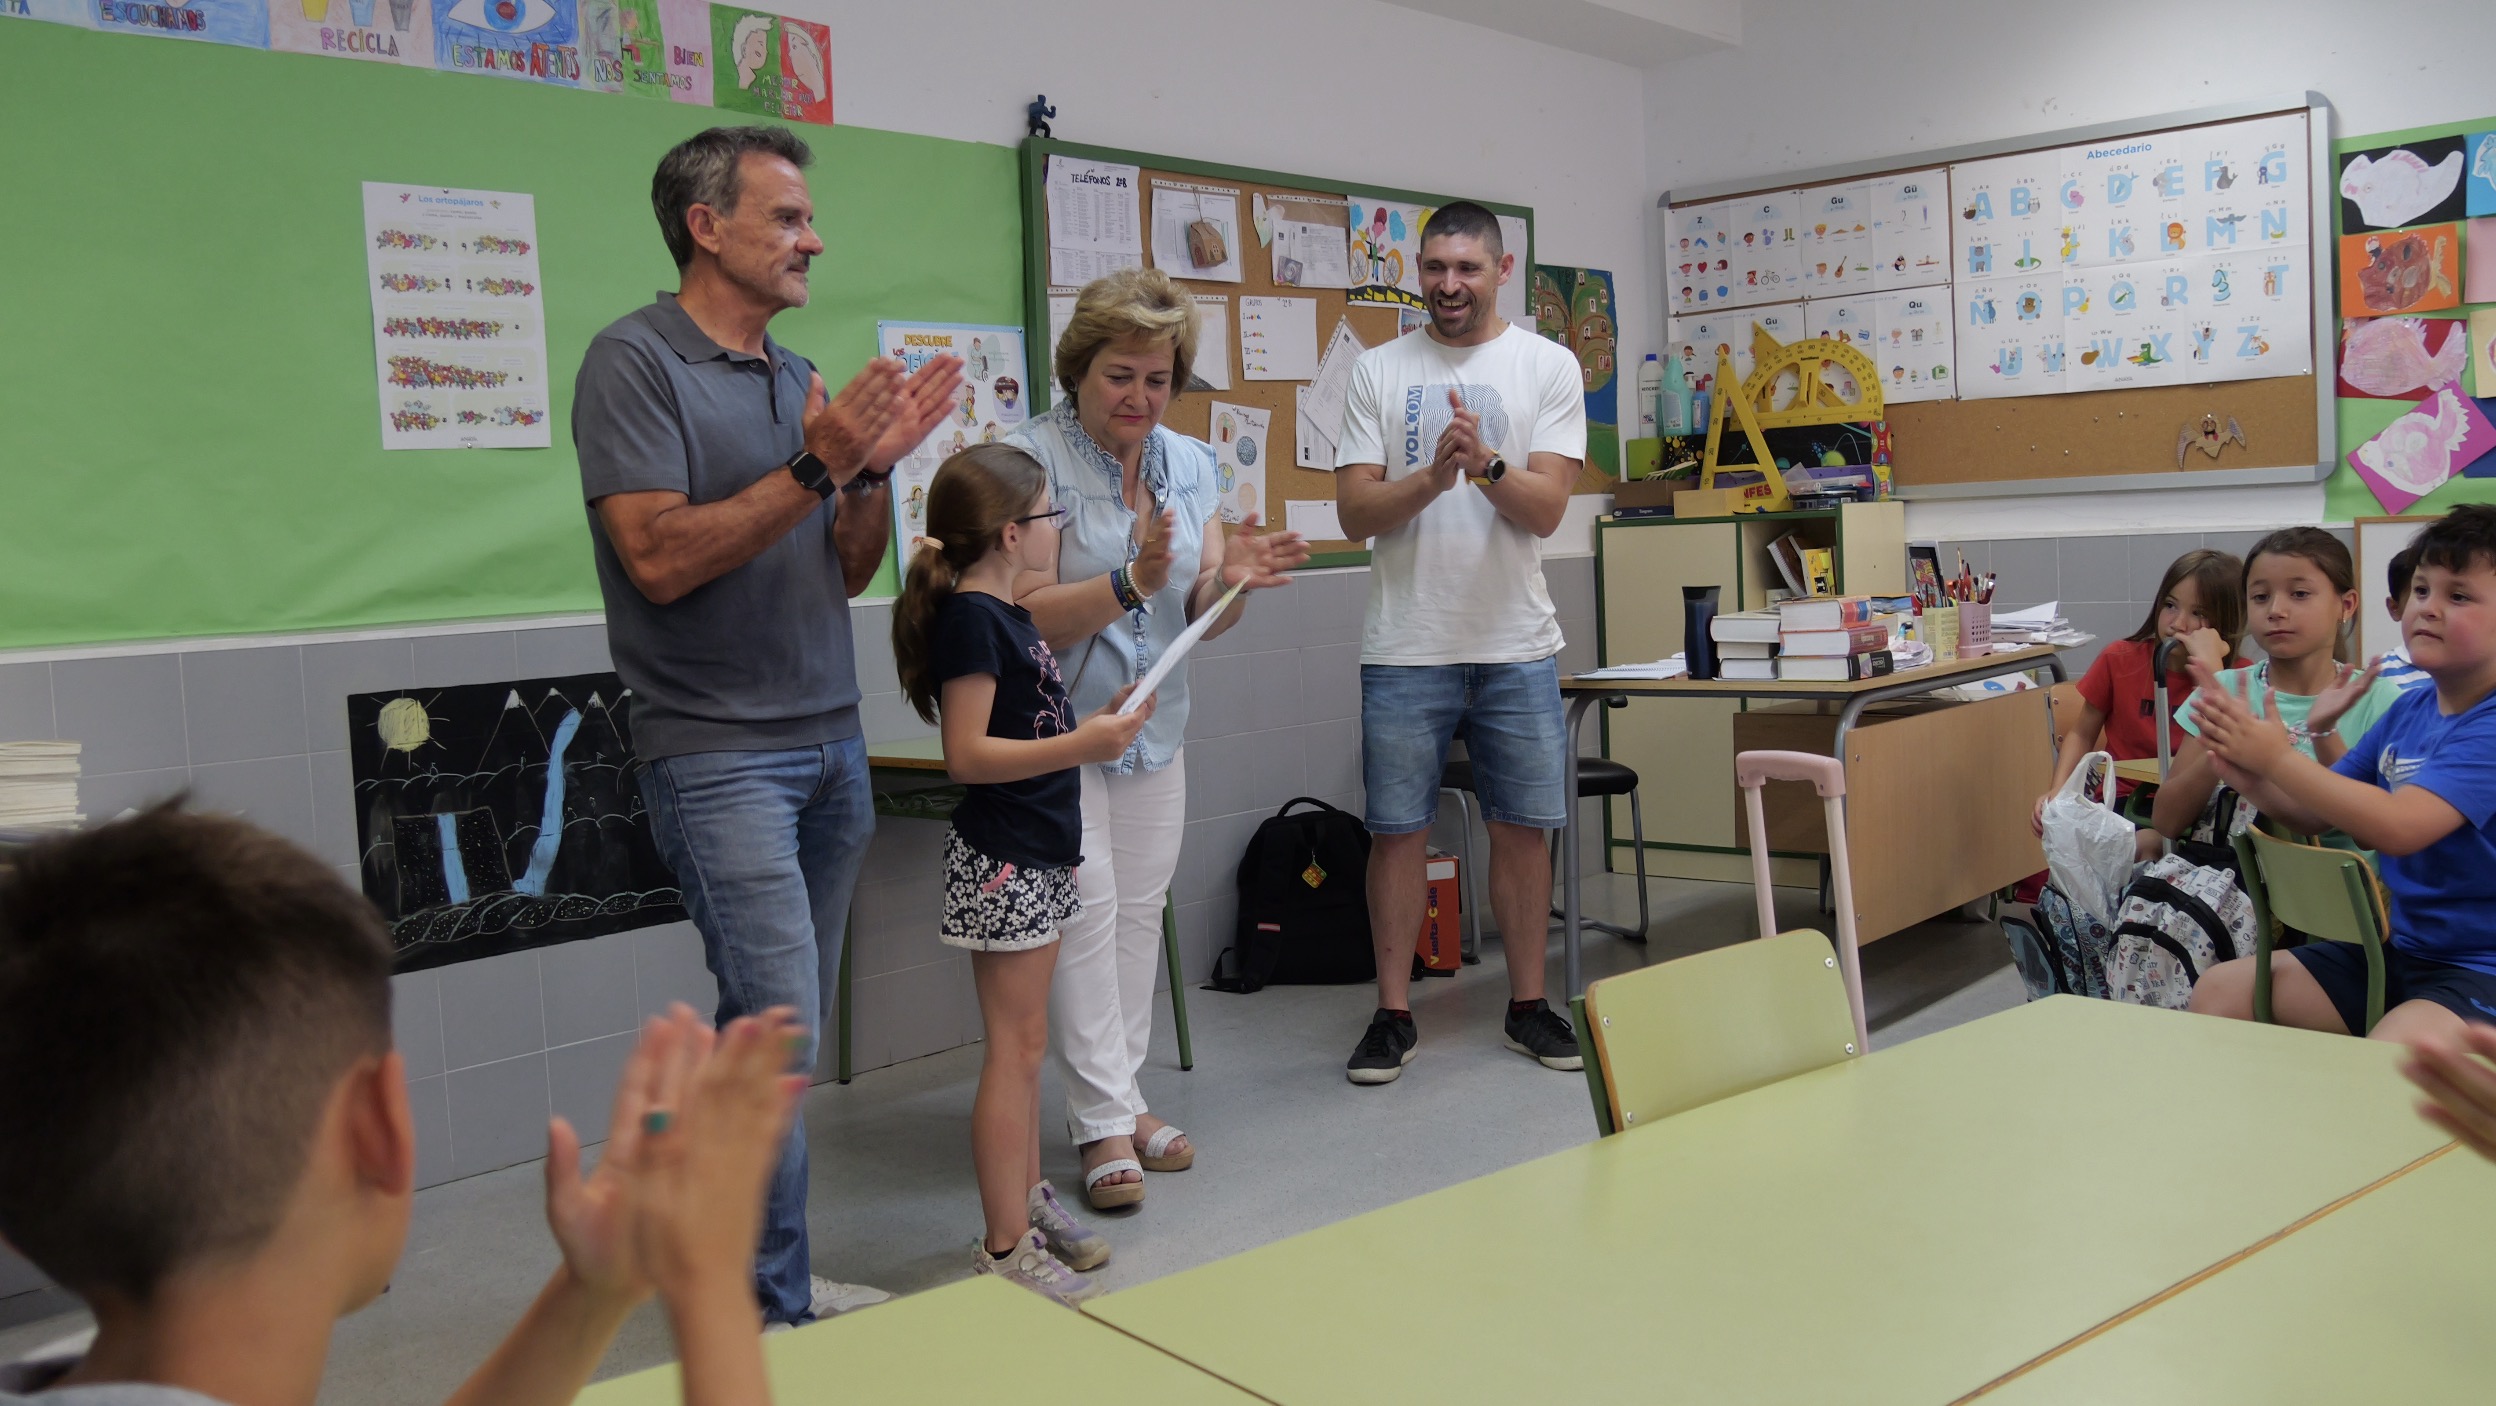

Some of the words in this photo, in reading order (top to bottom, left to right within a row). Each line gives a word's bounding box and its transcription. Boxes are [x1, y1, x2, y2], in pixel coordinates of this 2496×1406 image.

[100, 0, 207, 32] ESCUCHAMOS
[452, 44, 526, 72] ESTAMOS
[529, 42, 580, 80] ATENTOS
[673, 45, 705, 68] BIEN
[594, 59, 624, 82] NOS
[633, 69, 692, 91] SENTAMOS
[2087, 142, 2152, 161] Abecedario
[2260, 151, 2287, 182] G
[1071, 169, 1110, 186] TELÉFONOS
[1904, 184, 1918, 194] Gü
[2107, 173, 2132, 204] D
[2164, 165, 2185, 197] E
[2205, 160, 2223, 191] F
[418, 195, 433, 203] Los
[436, 197, 484, 207] ortopájaros
[1972, 192, 1994, 221] A
[2010, 187, 2031, 216] B
[2060, 179, 2079, 209] C
[2160, 222, 2179, 252] L
[2206, 216, 2236, 247] M
[2261, 208, 2287, 240] N
[2108, 226, 2132, 257] K
[1969, 244, 1992, 274] H
[2165, 275, 2188, 306] R
[2267, 264, 2289, 296] T
[1970, 294, 1991, 325] Ñ
[2016, 291, 2042, 320] O
[2063, 286, 2086, 316] P
[2108, 281, 2136, 311] Q
[904, 334, 952, 348] DESCUBRE
[2090, 337, 2123, 368] W
[2149, 332, 2174, 363] X
[2192, 328, 2217, 360] Y
[2236, 325, 2260, 357] Z
[2000, 346, 2022, 376] U
[2043, 343, 2064, 372] V
[1405, 385, 1423, 466] VOLCOM
